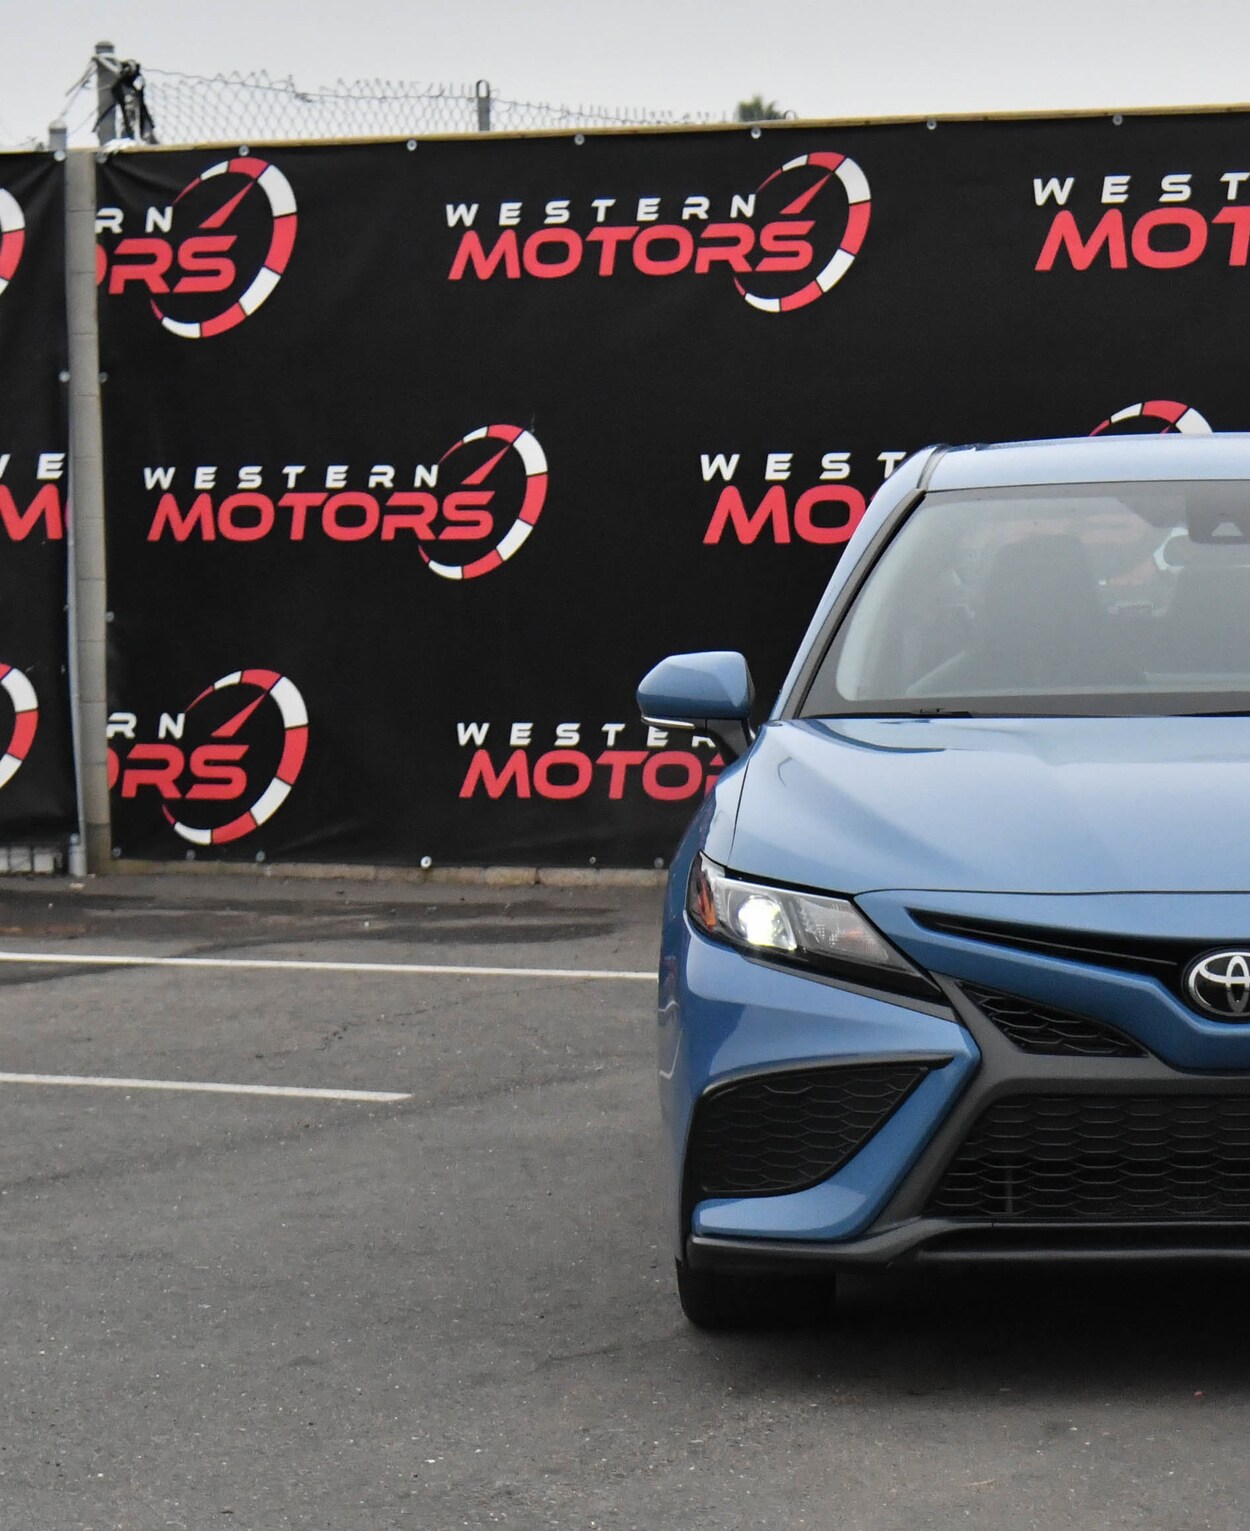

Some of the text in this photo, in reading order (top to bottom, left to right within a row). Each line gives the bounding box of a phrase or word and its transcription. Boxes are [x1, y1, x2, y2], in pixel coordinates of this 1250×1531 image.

[446, 193, 756, 228] WESTERN
[449, 220, 815, 281] MOTORS
[144, 464, 439, 490] WESTERN
[148, 490, 495, 542] MOTORS
[703, 484, 867, 545] MO
[459, 749, 725, 801] MOTO
